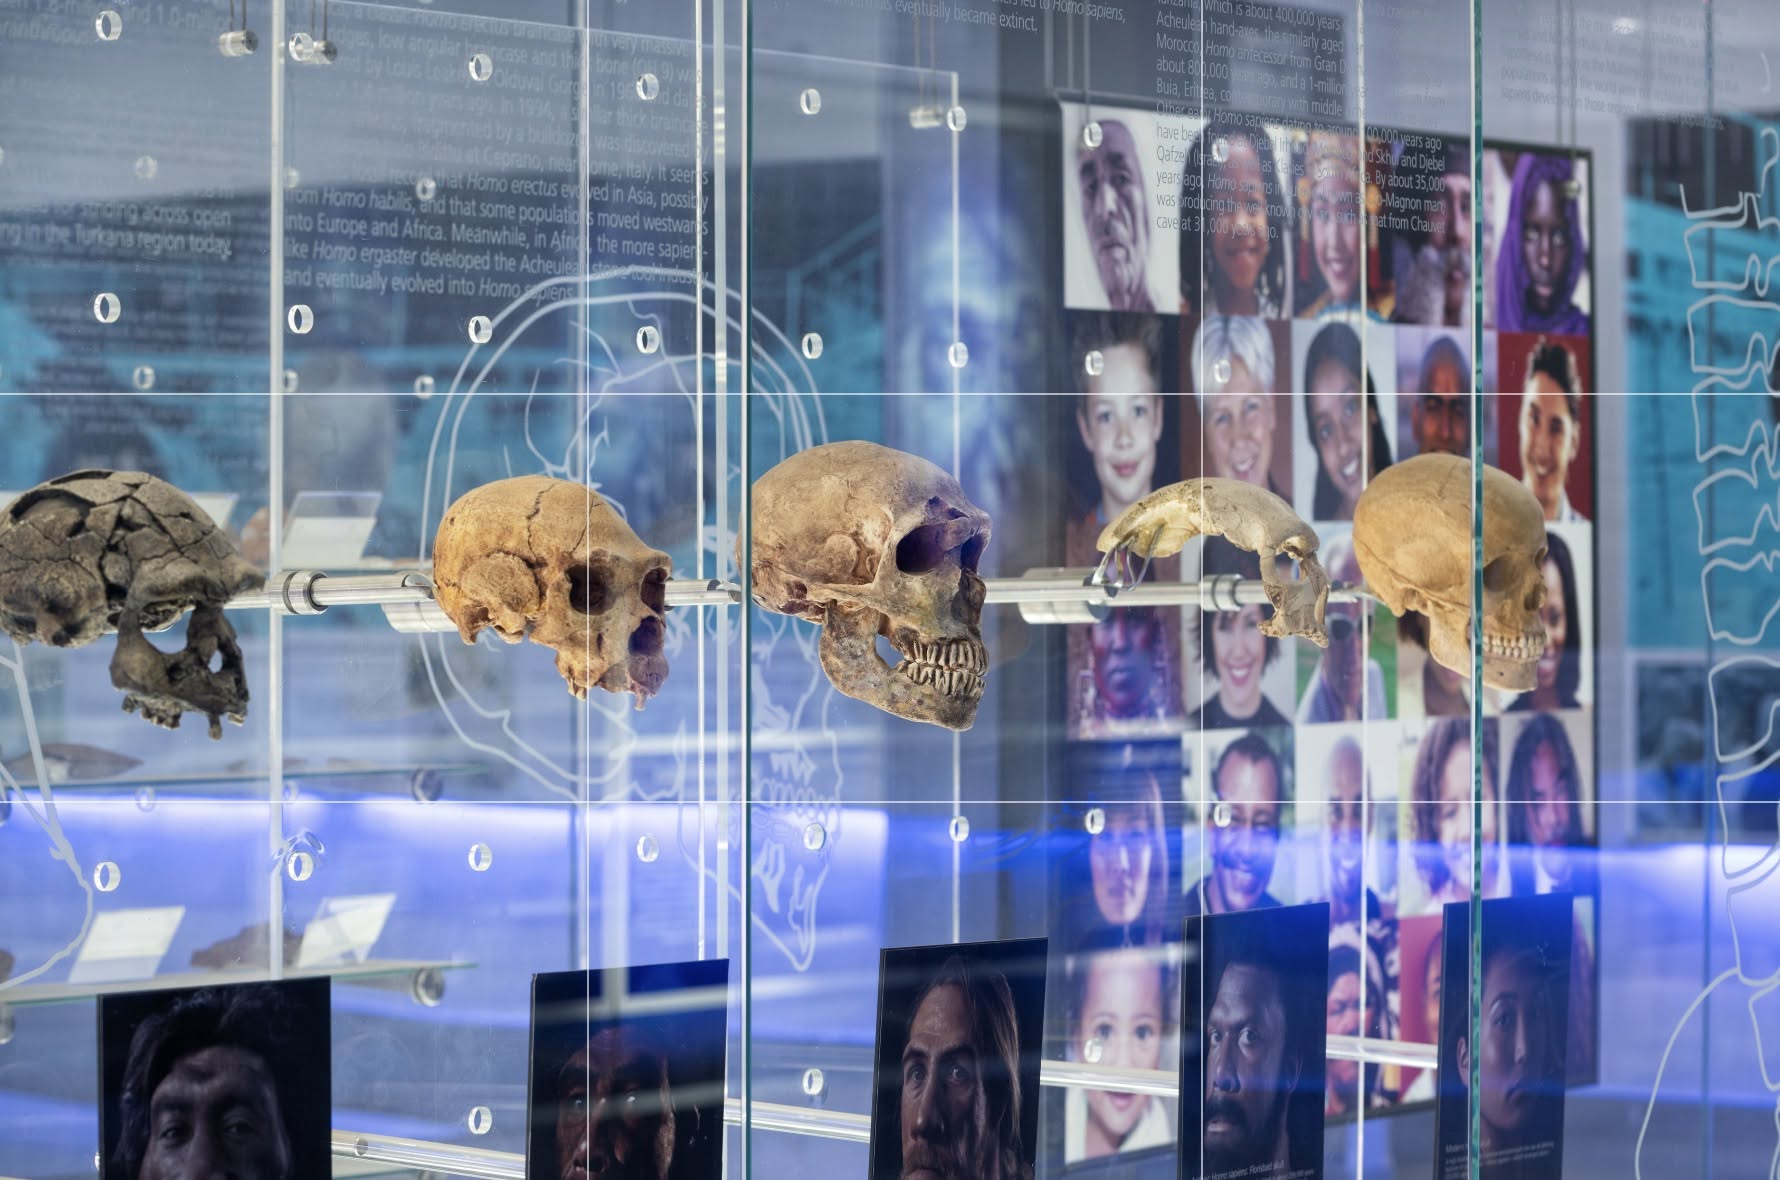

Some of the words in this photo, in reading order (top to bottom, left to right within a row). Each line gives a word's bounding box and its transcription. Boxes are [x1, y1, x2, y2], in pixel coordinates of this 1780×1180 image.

[895, 0, 951, 22] eventually
[953, 3, 996, 25] became
[999, 11, 1038, 31] extinct.
[1040, 0, 1050, 10] to
[1053, 0, 1084, 15] Homo
[1085, 2, 1126, 24] sapiens,
[1156, 10, 1208, 32] Acheulean
[1204, 0, 1233, 14] which
[1235, 2, 1243, 16] is
[1245, 3, 1273, 20] about
[1275, 6, 1315, 28] 400,000
[1316, 15, 1341, 32] years
[378, 26, 405, 49] low
[408, 34, 460, 57] angular
[532, 49, 557, 67] and
[596, 56, 621, 74] bone
[612, 33, 638, 55] very
[1206, 39, 1235, 58] Homo
[1238, 48, 1287, 65] antecessor
[1289, 50, 1312, 69] from
[1314, 55, 1337, 73] Gran
[1156, 55, 1186, 74] about
[1188, 60, 1228, 80] 800,000
[1280, 72, 1298, 89] and
[1156, 78, 1181, 97] Buia,
[1184, 81, 1217, 102] Eritea,
[1311, 96, 1343, 116] middle
[1156, 122, 1181, 140] have
[1401, 153, 1418, 169] and
[1419, 154, 1446, 173] Djebel
[1213, 107, 1243, 125] Homo
[1245, 112, 1280, 131] sapiens
[1361, 125, 1398, 145] 00,000
[1400, 131, 1423, 149] years
[1425, 137, 1442, 154] ago
[467, 171, 507, 193] Homo
[511, 179, 558, 198] erectus
[561, 183, 609, 203] evoved
[613, 184, 624, 203] in
[628, 185, 657, 208] Asia,
[661, 189, 709, 215] possiby
[1156, 169, 1181, 187] years
[1207, 172, 1237, 191] Homo
[1364, 190, 1421, 213] o-Magnon
[1375, 169, 1386, 190] By
[1388, 170, 1414, 190] about
[1415, 174, 1446, 193] 35,000
[322, 185, 366, 208] Homo
[370, 189, 416, 216] habilis,
[419, 194, 446, 215] and
[449, 196, 477, 217] that
[480, 201, 515, 219] some
[519, 202, 593, 226] populatios
[597, 209, 640, 230] moved
[643, 214, 709, 237] westwars
[1181, 217, 1192, 231] at
[1226, 197, 1241, 211] the
[1389, 212, 1410, 230] from
[1411, 214, 1446, 234] Chauvet
[316, 211, 368, 239] Europe
[371, 216, 399, 239] and
[402, 217, 447, 242] Africa.
[450, 222, 530, 250] Meanwhile,
[534, 229, 547, 249] in
[550, 230, 592, 254] Afric,
[597, 234, 618, 254] the
[621, 240, 655, 258] more
[658, 242, 709, 263] sapien-
[313, 239, 358, 264] Homo
[360, 244, 417, 269] ergaster
[420, 244, 491, 273] developed
[494, 252, 517, 273] the
[520, 254, 589, 277] Acheulea
[283, 264, 313, 287] and
[315, 268, 388, 296] eventually
[391, 272, 445, 295] evolved
[448, 273, 476, 296] into
[478, 277, 521, 299] Homo
[525, 284, 574, 307] spiens
